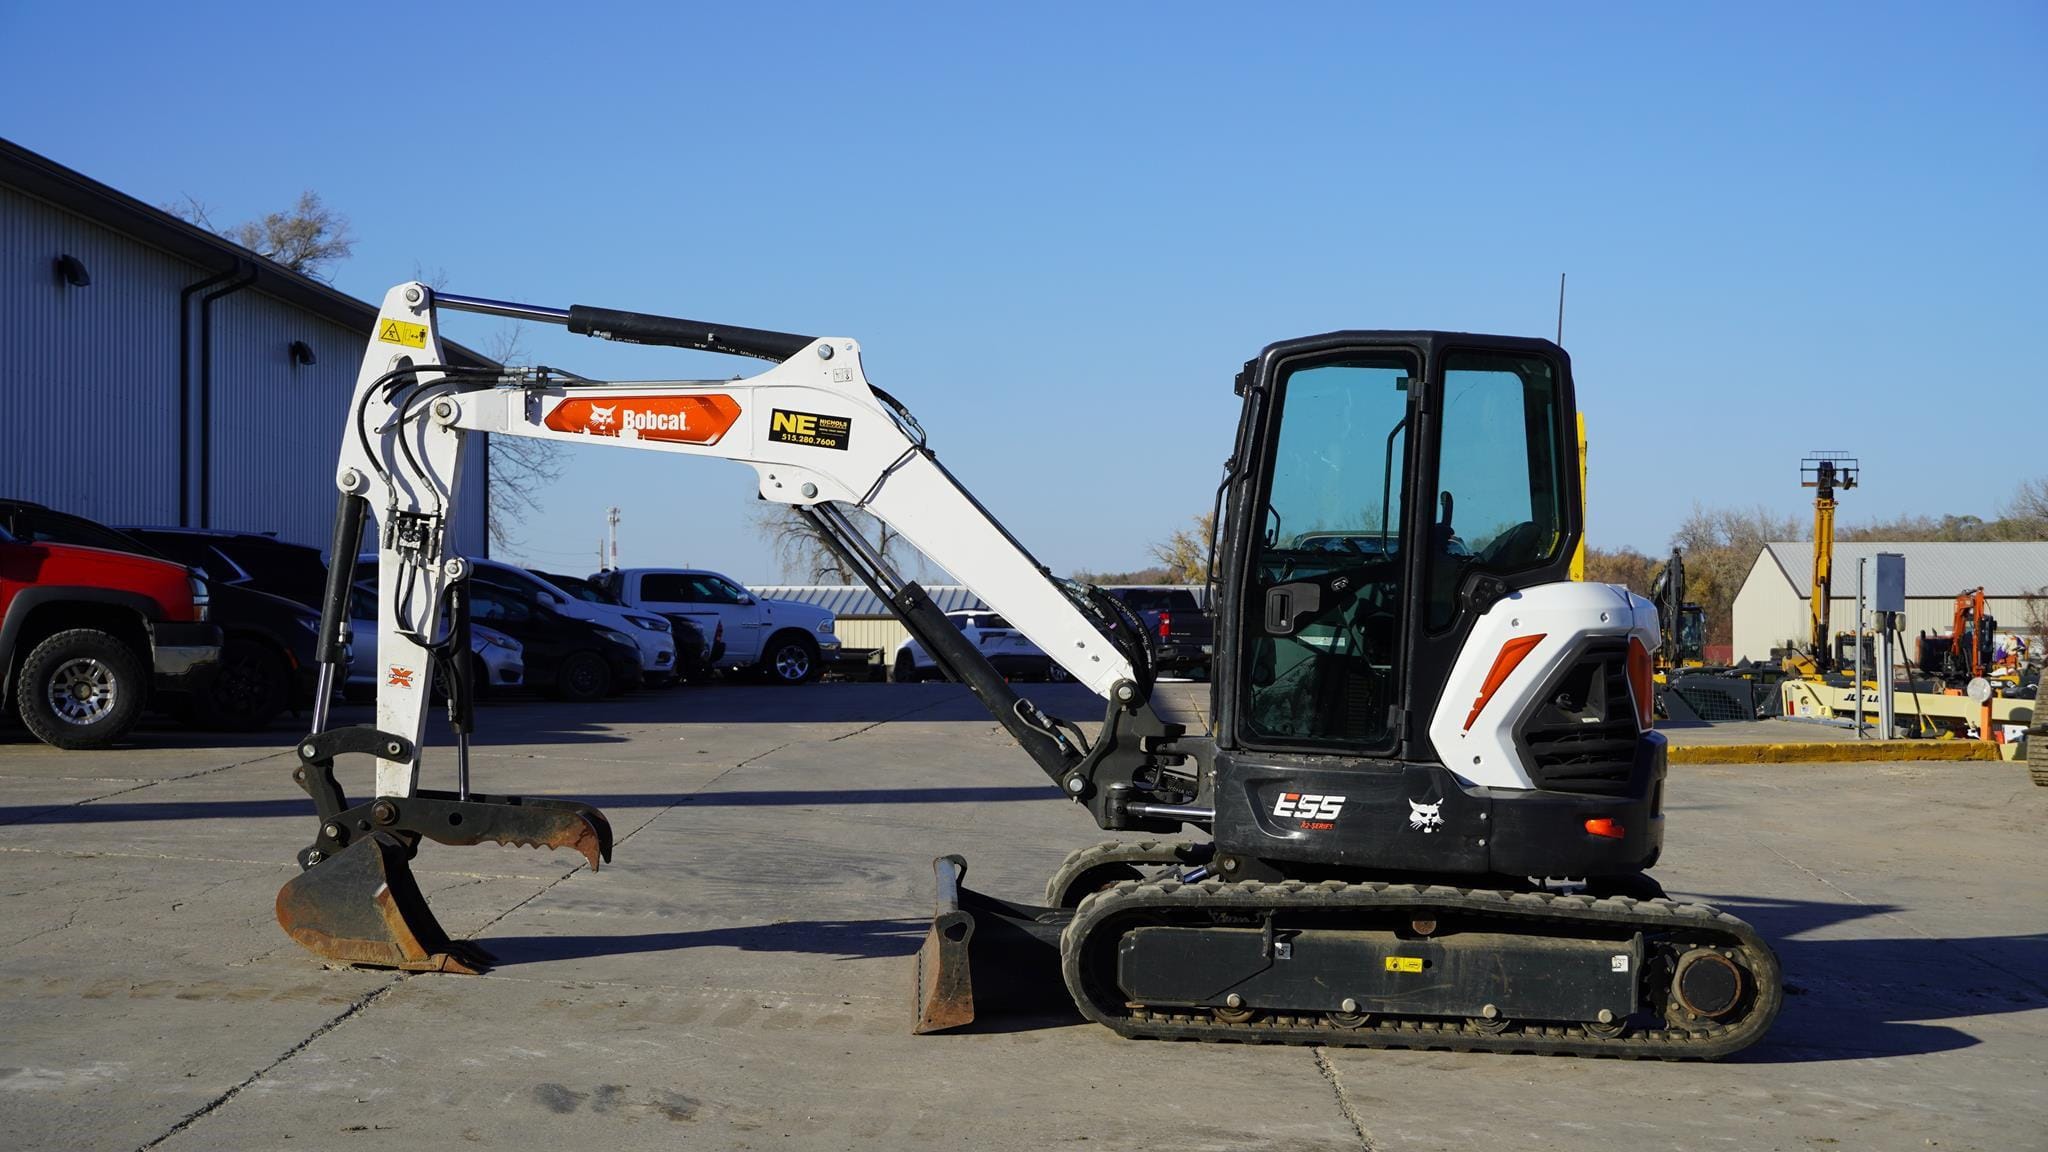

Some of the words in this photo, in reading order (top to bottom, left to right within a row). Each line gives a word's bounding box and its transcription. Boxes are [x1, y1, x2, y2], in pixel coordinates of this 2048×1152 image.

[623, 410, 686, 430] Bobcat
[773, 412, 817, 435] NE
[819, 419, 847, 427] NICHOLS
[781, 433, 836, 447] 515.280.7600
[1273, 793, 1346, 819] E55
